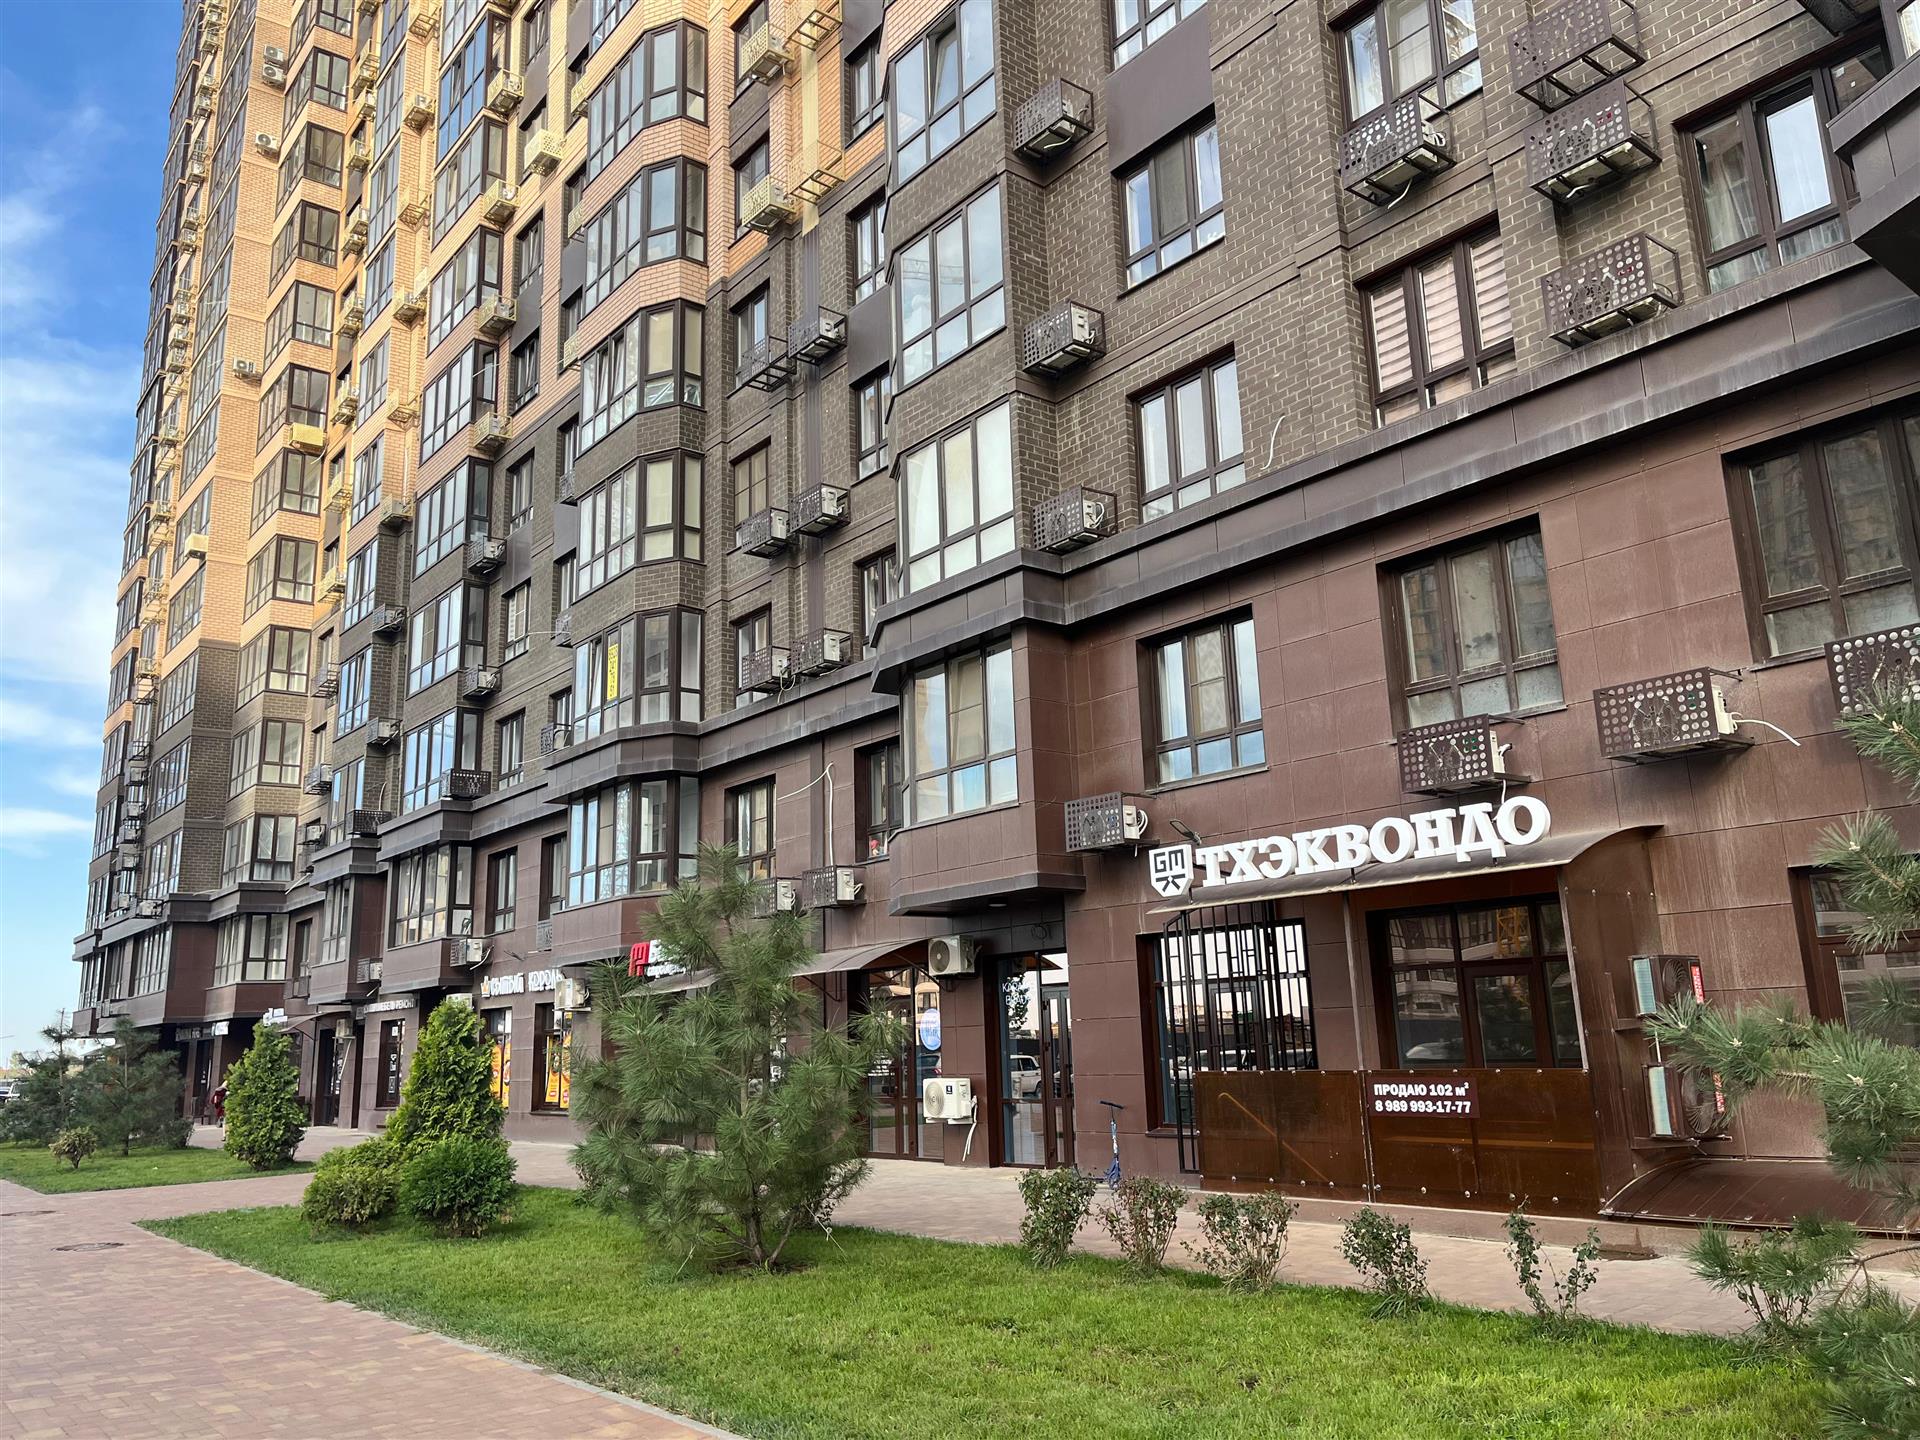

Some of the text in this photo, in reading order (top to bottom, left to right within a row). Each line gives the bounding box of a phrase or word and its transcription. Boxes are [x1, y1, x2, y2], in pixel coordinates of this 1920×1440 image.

[1196, 795, 1551, 888] ТХЭКВОНДО
[1373, 1083, 1427, 1098] ПРОДАЮ
[1429, 1083, 1453, 1097] 102
[1375, 1100, 1472, 1114] 8 989 993-17-77
